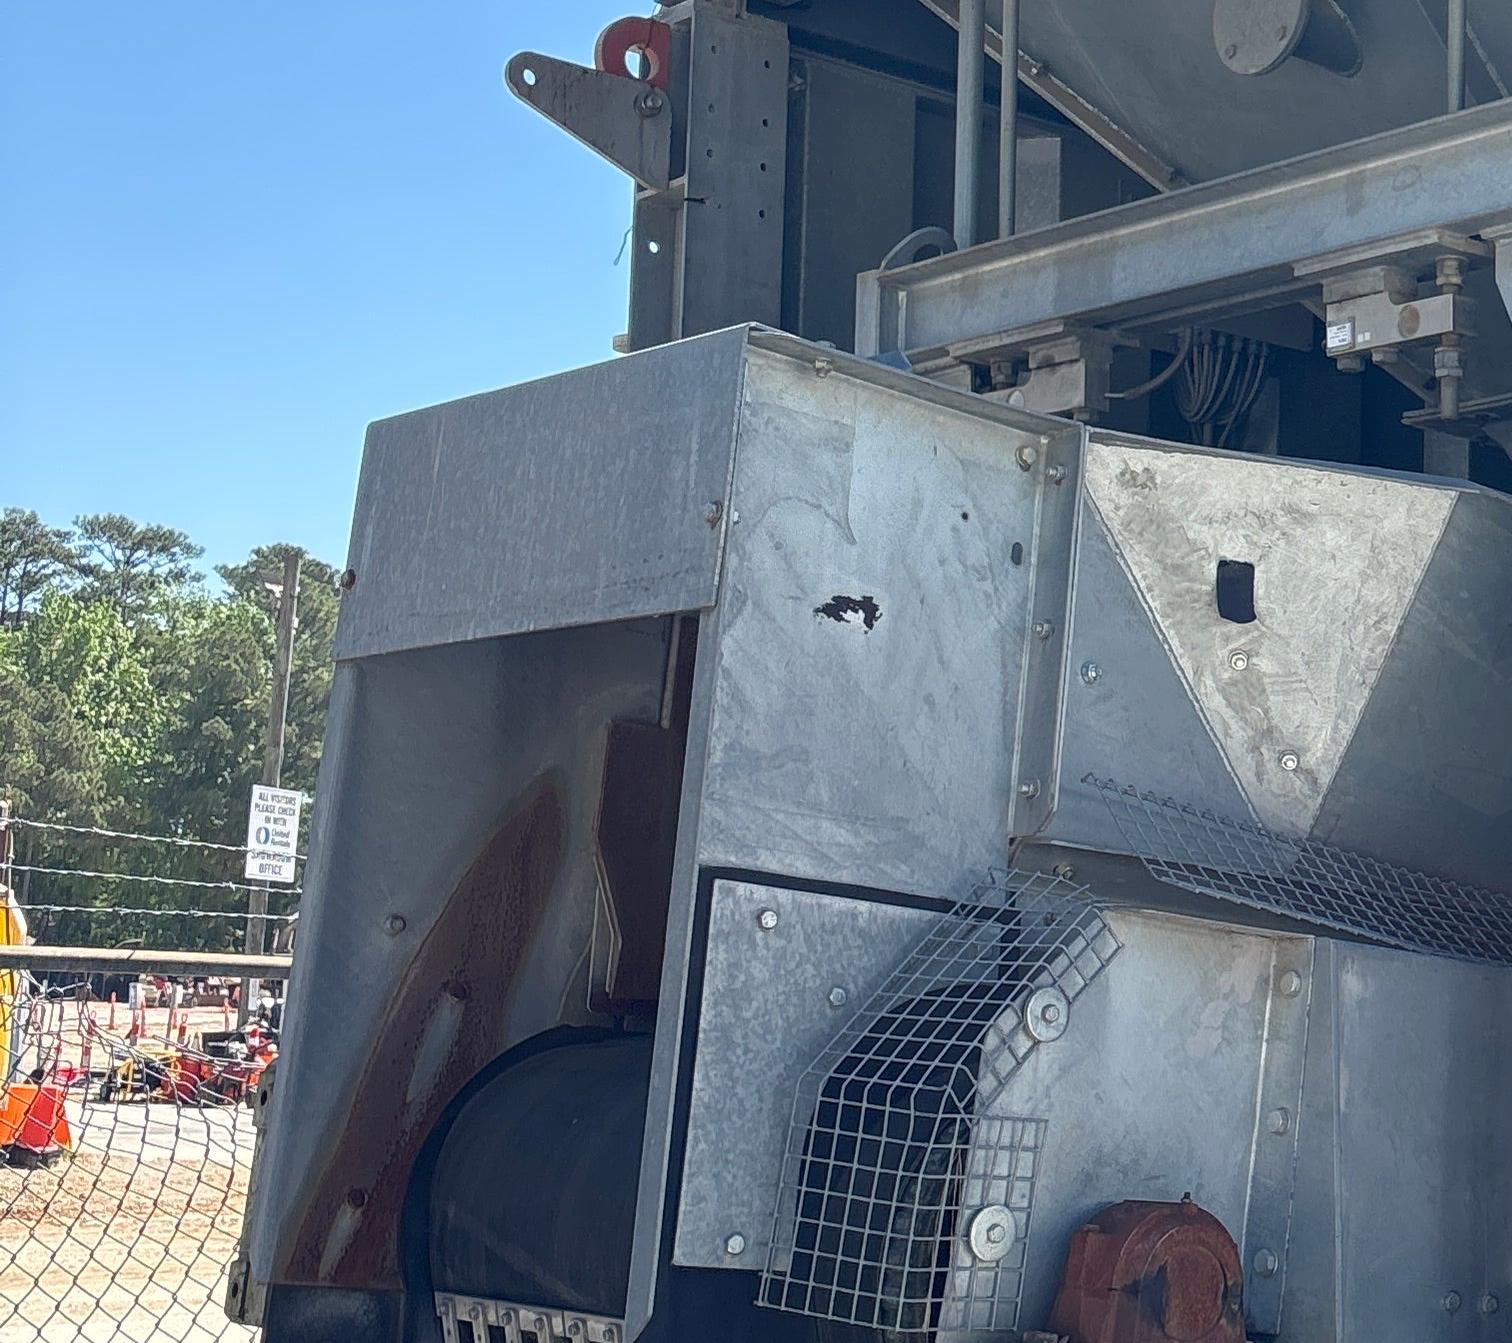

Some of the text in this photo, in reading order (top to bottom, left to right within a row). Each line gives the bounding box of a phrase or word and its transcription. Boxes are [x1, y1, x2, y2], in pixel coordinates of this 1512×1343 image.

[258, 792, 269, 802] ALL
[254, 803, 296, 816] PLEASE CHECK
[271, 828, 290, 839] United
[258, 863, 283, 876] OFFICE
